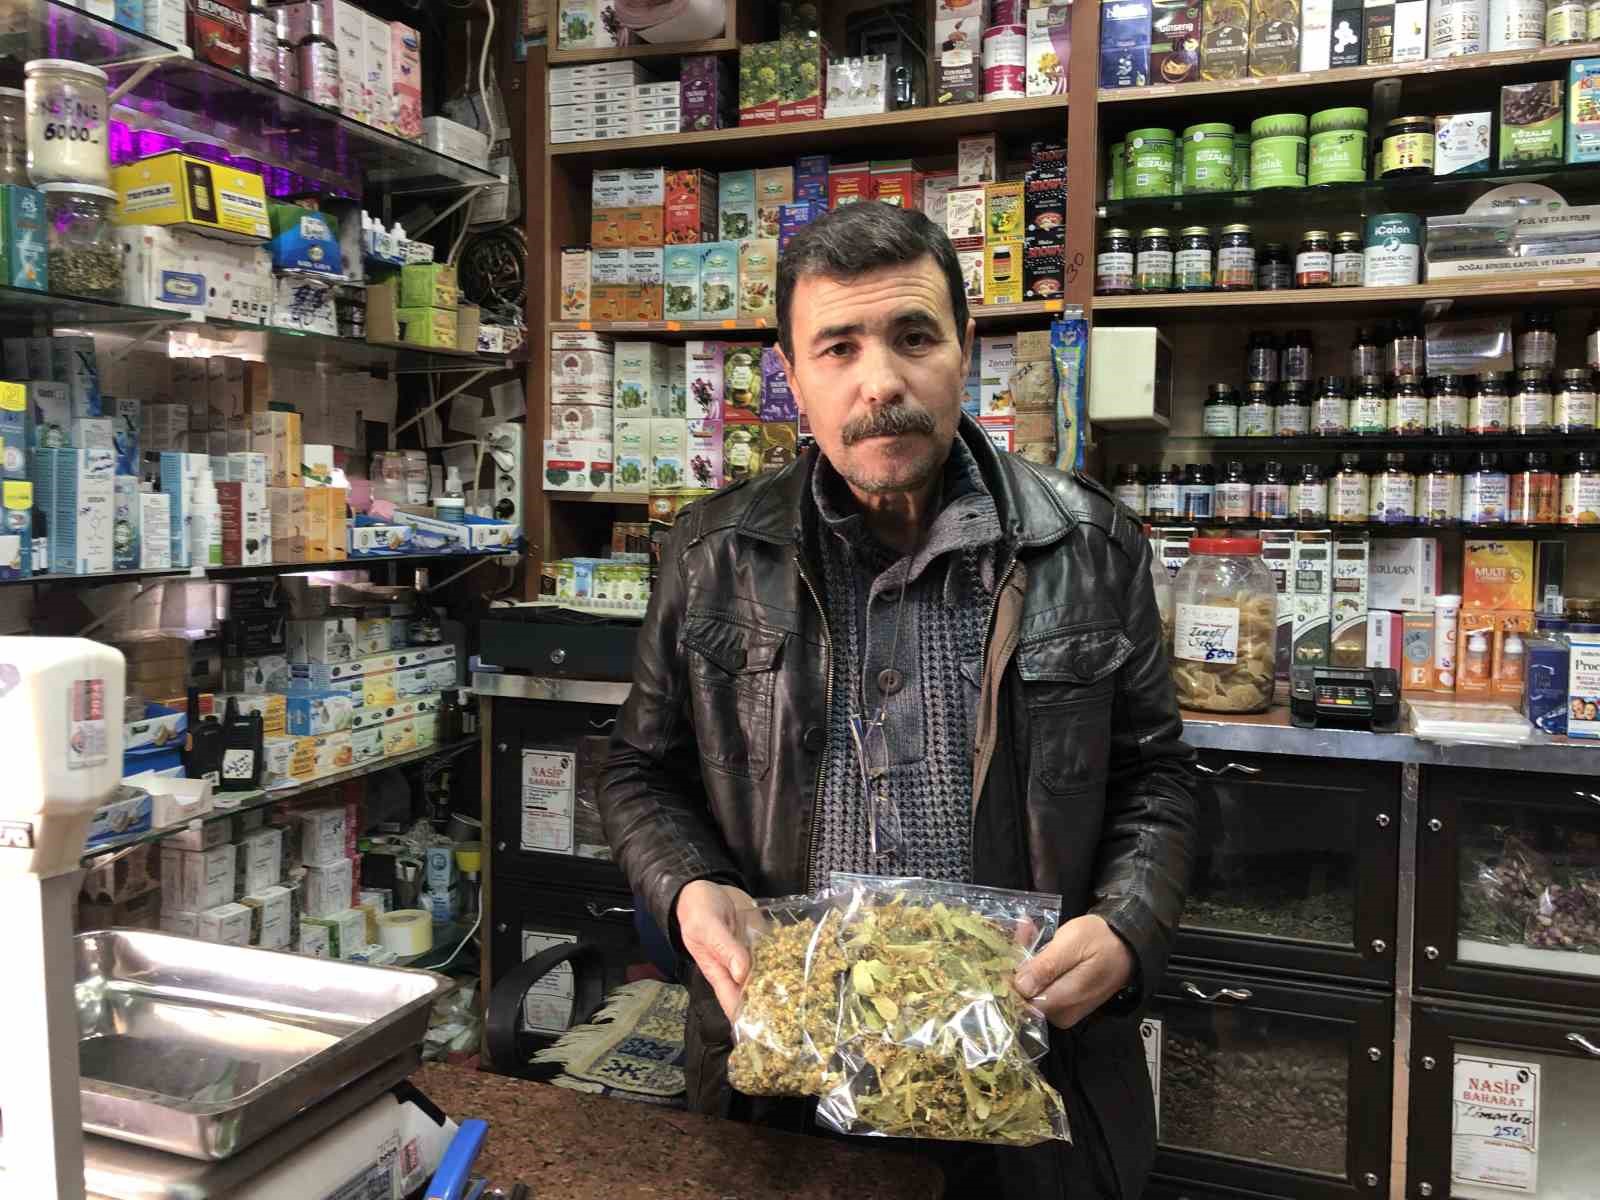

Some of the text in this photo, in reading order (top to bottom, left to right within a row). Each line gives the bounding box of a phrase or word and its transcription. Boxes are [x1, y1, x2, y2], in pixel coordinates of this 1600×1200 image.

[1160, 23, 1193, 33] Ginseng
[1375, 224, 1411, 236] iColon
[1475, 567, 1506, 577] MULTI
[1468, 1077, 1521, 1095] NASİP
[1463, 1091, 1526, 1107] BAHARAT
